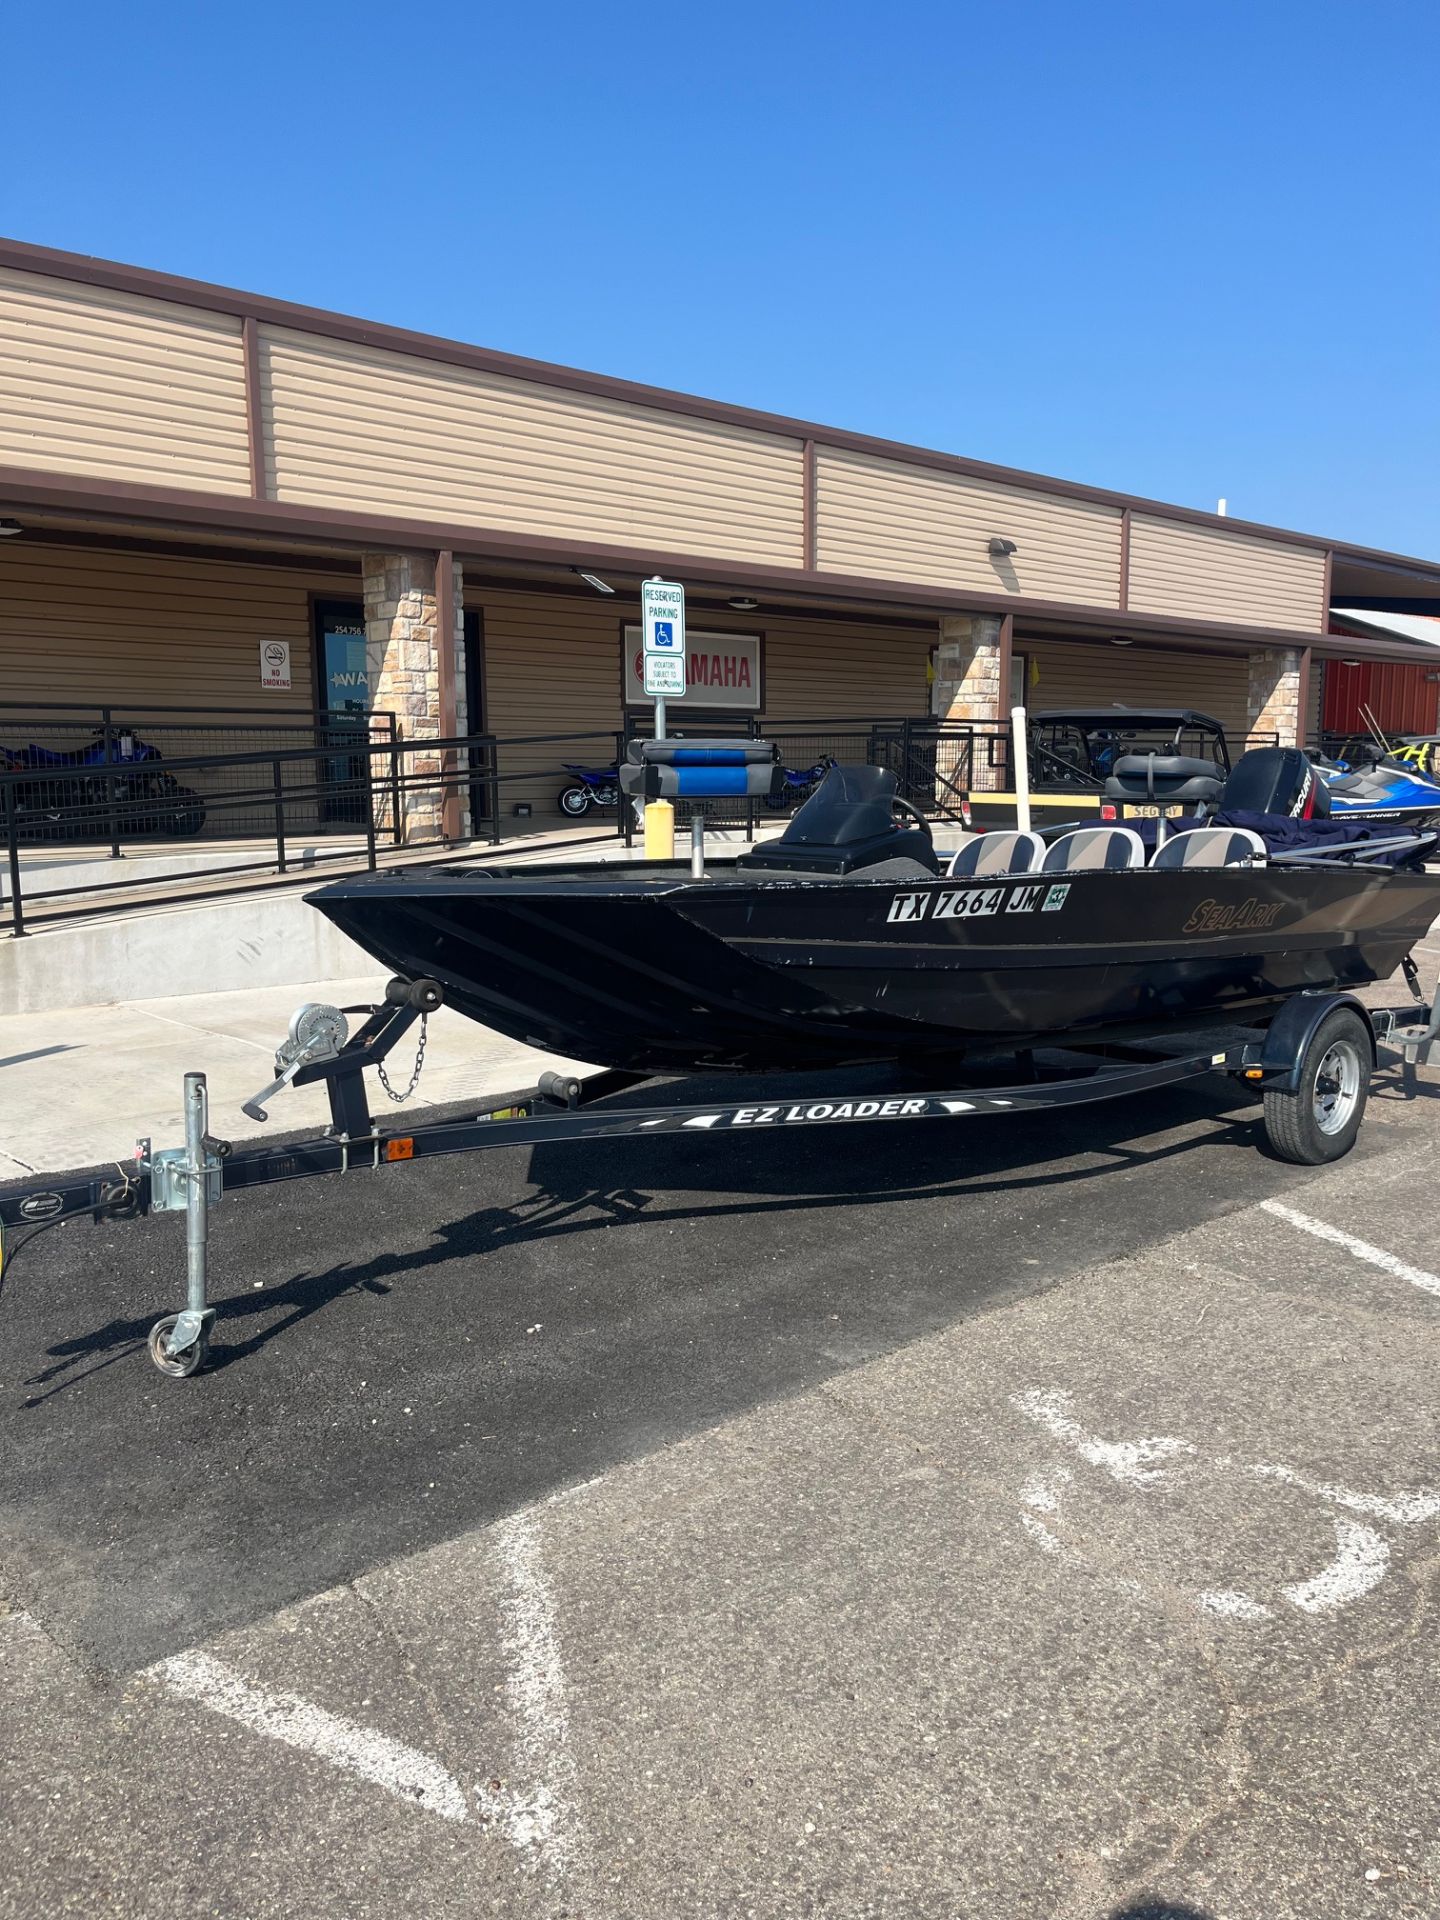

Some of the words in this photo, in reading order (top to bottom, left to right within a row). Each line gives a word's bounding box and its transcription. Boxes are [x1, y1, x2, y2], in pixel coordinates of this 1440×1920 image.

[645, 589, 681, 603] RESERVED
[649, 606, 678, 619] PARKING
[335, 625, 348, 634] 254
[653, 661, 676, 669] VIOLATORS
[685, 653, 751, 688] MAHA
[271, 669, 281, 677] NO
[652, 670, 670, 678] SUBJECT
[262, 678, 290, 687] SMOKING
[647, 679, 656, 687] FINE
[656, 680, 665, 688] AND
[1289, 768, 1312, 818] ERCURY
[1134, 806, 1178, 817] SEGAY
[893, 893, 928, 920] TX
[935, 889, 1003, 917] 7664
[1009, 885, 1044, 910] JM
[731, 1107, 779, 1125] EZ
[784, 1099, 926, 1122] LOADER
